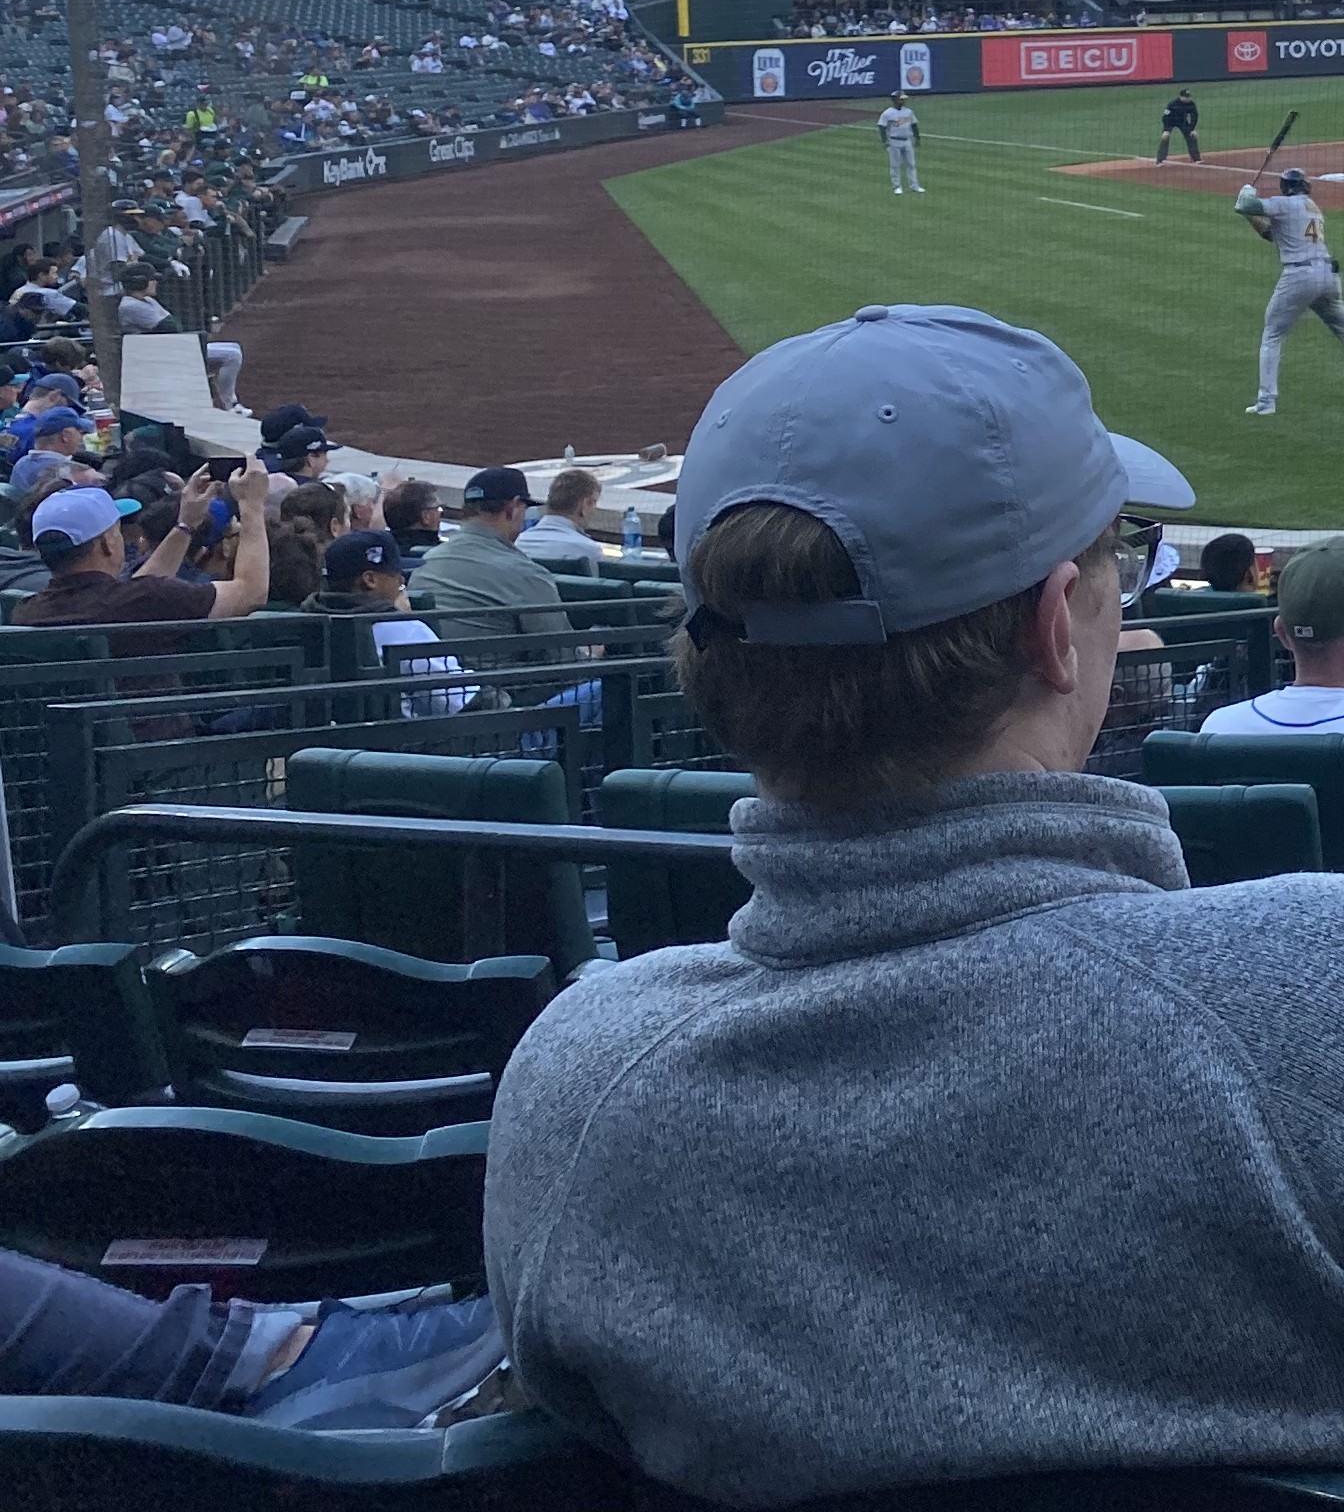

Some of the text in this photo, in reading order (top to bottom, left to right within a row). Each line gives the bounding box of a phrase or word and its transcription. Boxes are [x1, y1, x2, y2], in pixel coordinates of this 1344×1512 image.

[826, 48, 855, 61] IT'S
[1030, 47, 1129, 71] BECU
[807, 54, 878, 87] Miller
[840, 71, 876, 85] TIME
